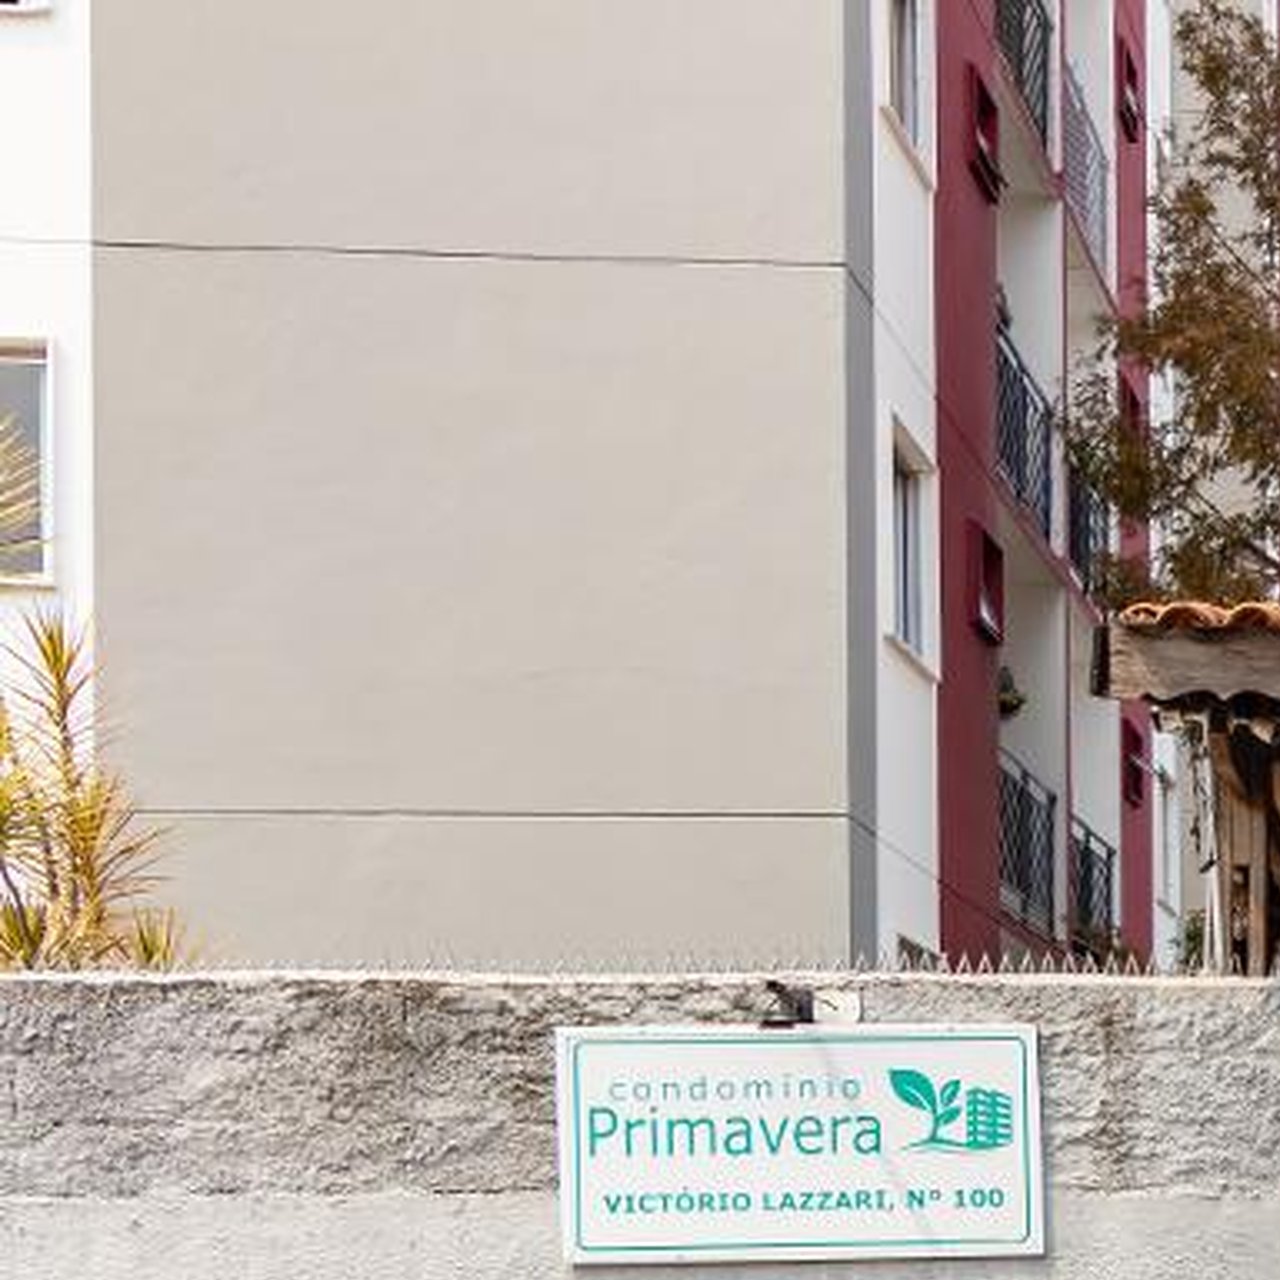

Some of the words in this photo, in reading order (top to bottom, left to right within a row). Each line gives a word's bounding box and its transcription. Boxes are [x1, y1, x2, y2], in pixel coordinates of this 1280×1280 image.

[588, 1107, 881, 1156] Primavera
[604, 1186, 752, 1213] VICTÓRIO
[763, 1191, 895, 1212] LAZZARI,
[954, 1188, 1005, 1209] 100
